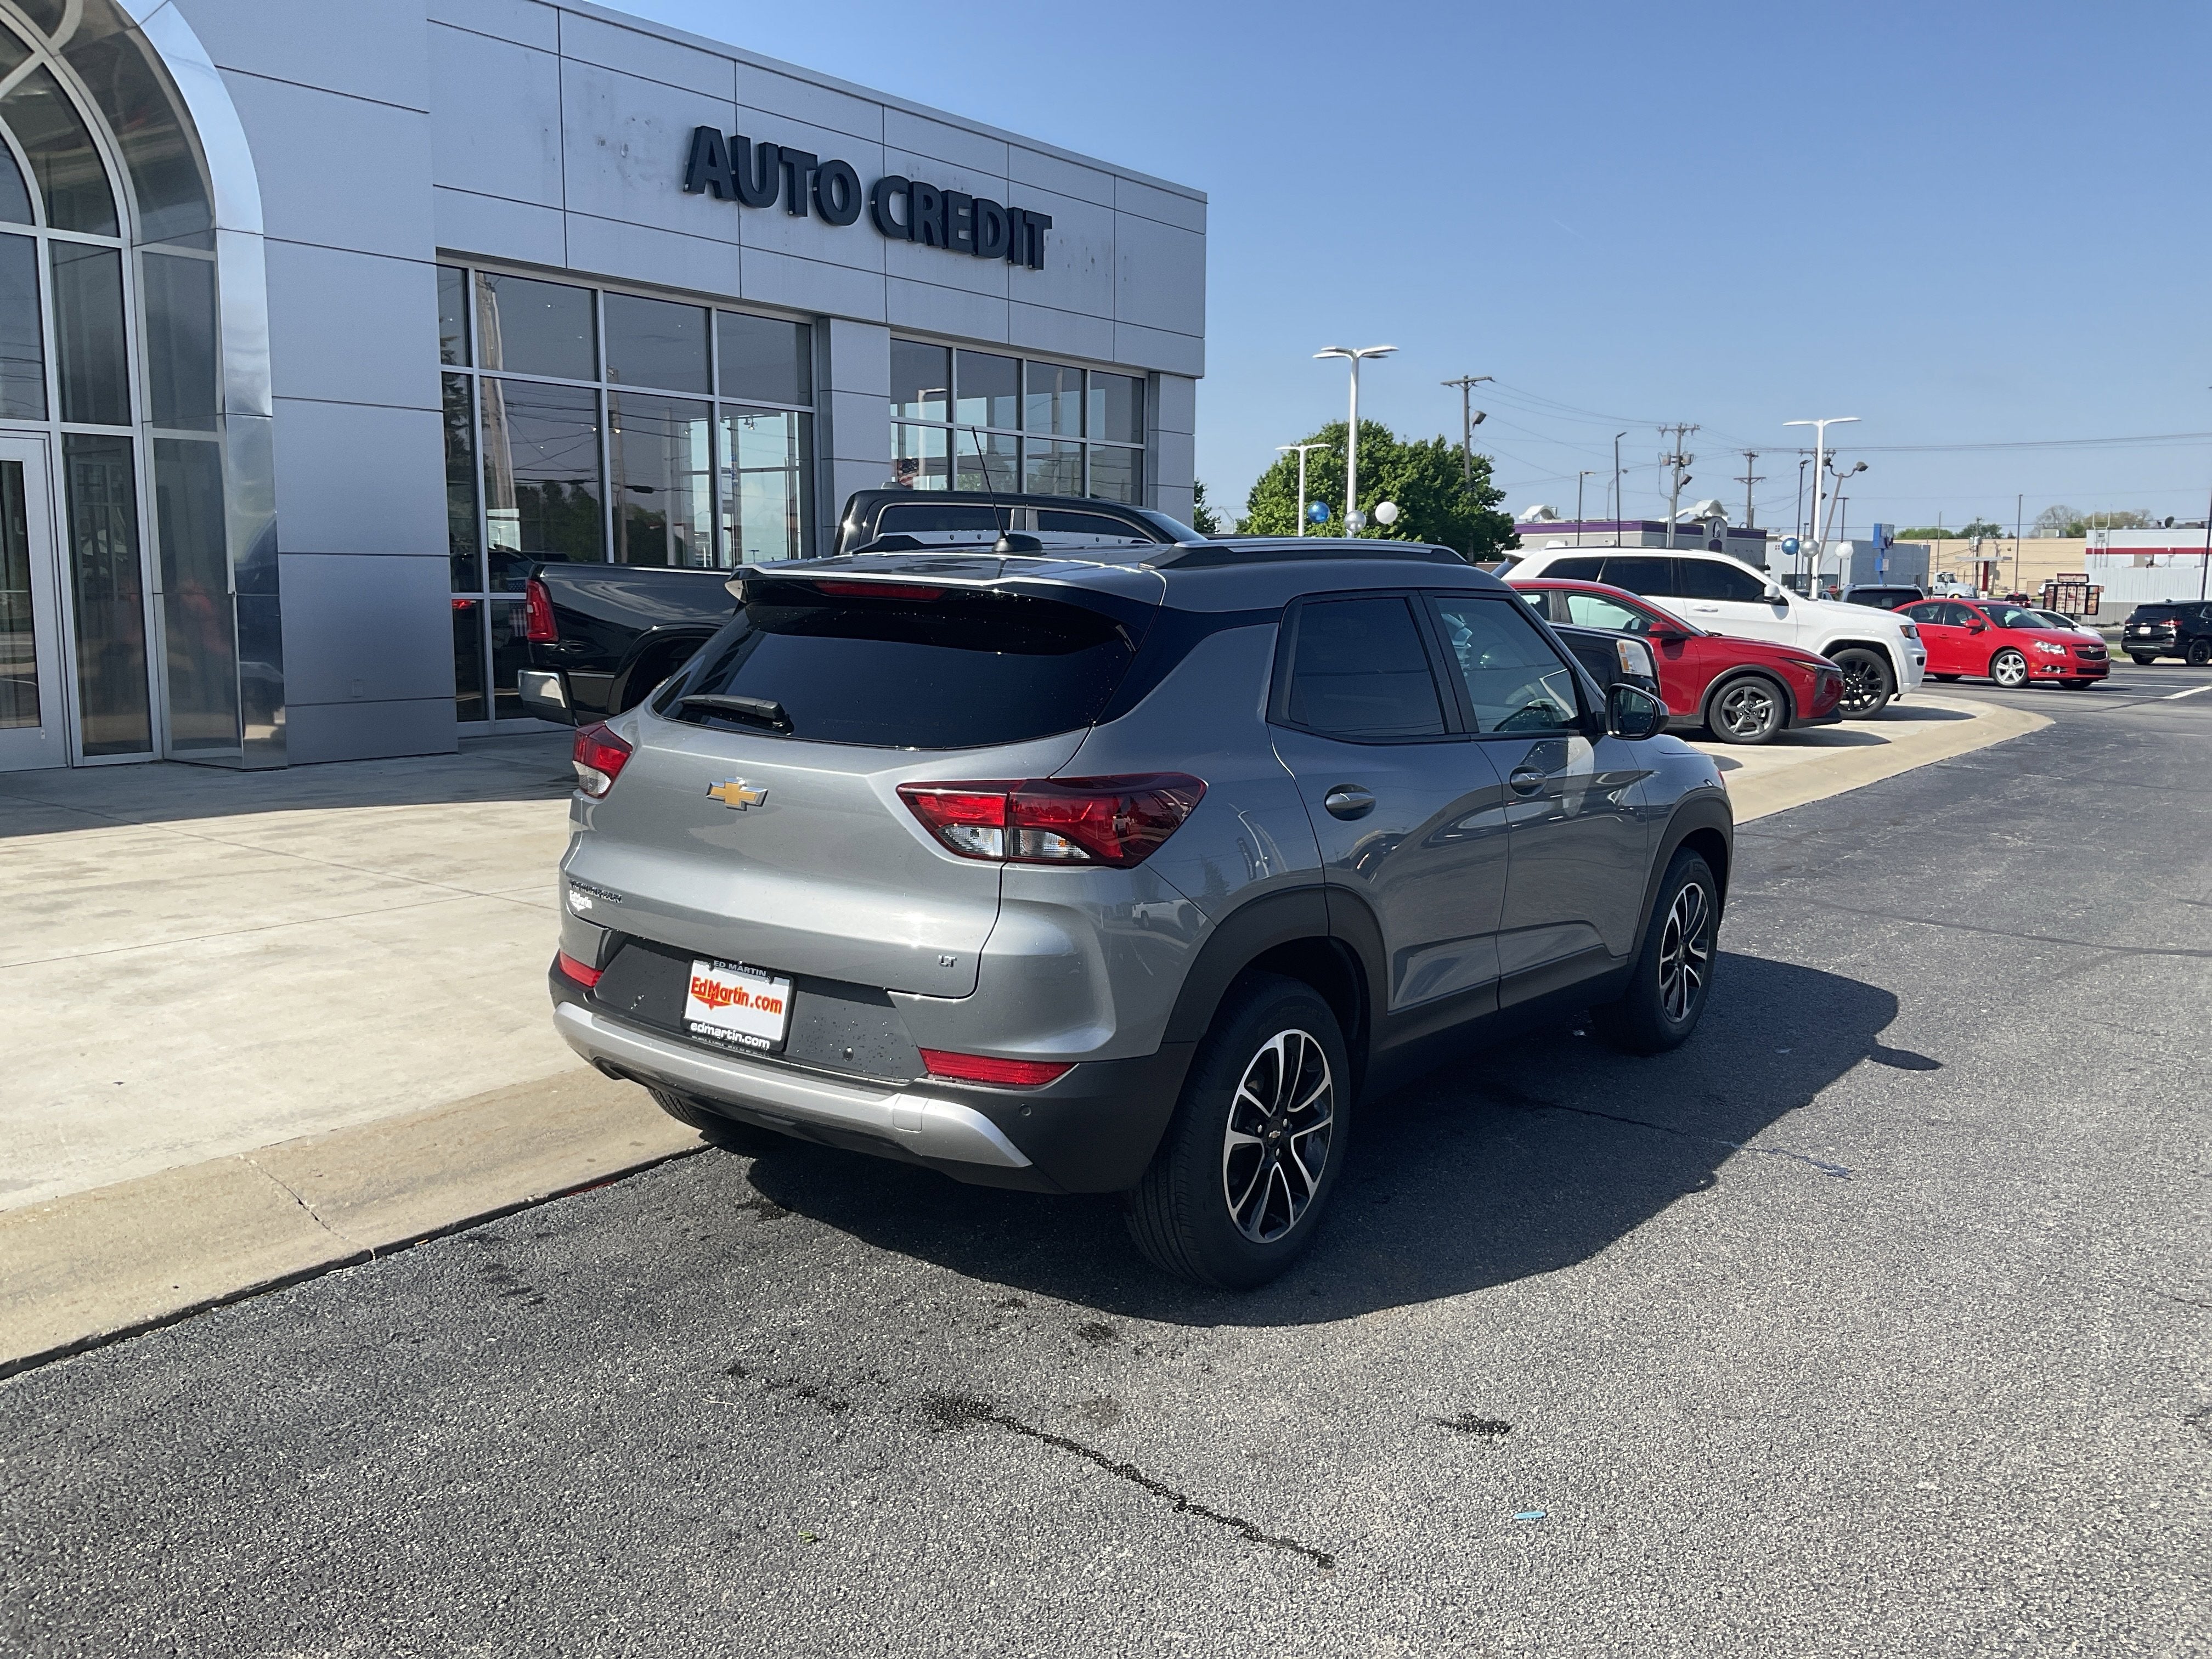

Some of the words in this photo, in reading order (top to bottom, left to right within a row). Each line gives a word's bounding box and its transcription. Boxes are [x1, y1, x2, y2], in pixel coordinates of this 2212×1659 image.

[683, 126, 862, 227] AUTO
[871, 175, 1053, 270] CREDIT
[728, 963, 766, 976] MARTIN
[938, 955, 957, 968] LT
[690, 1022, 770, 1049] edmartin.com
